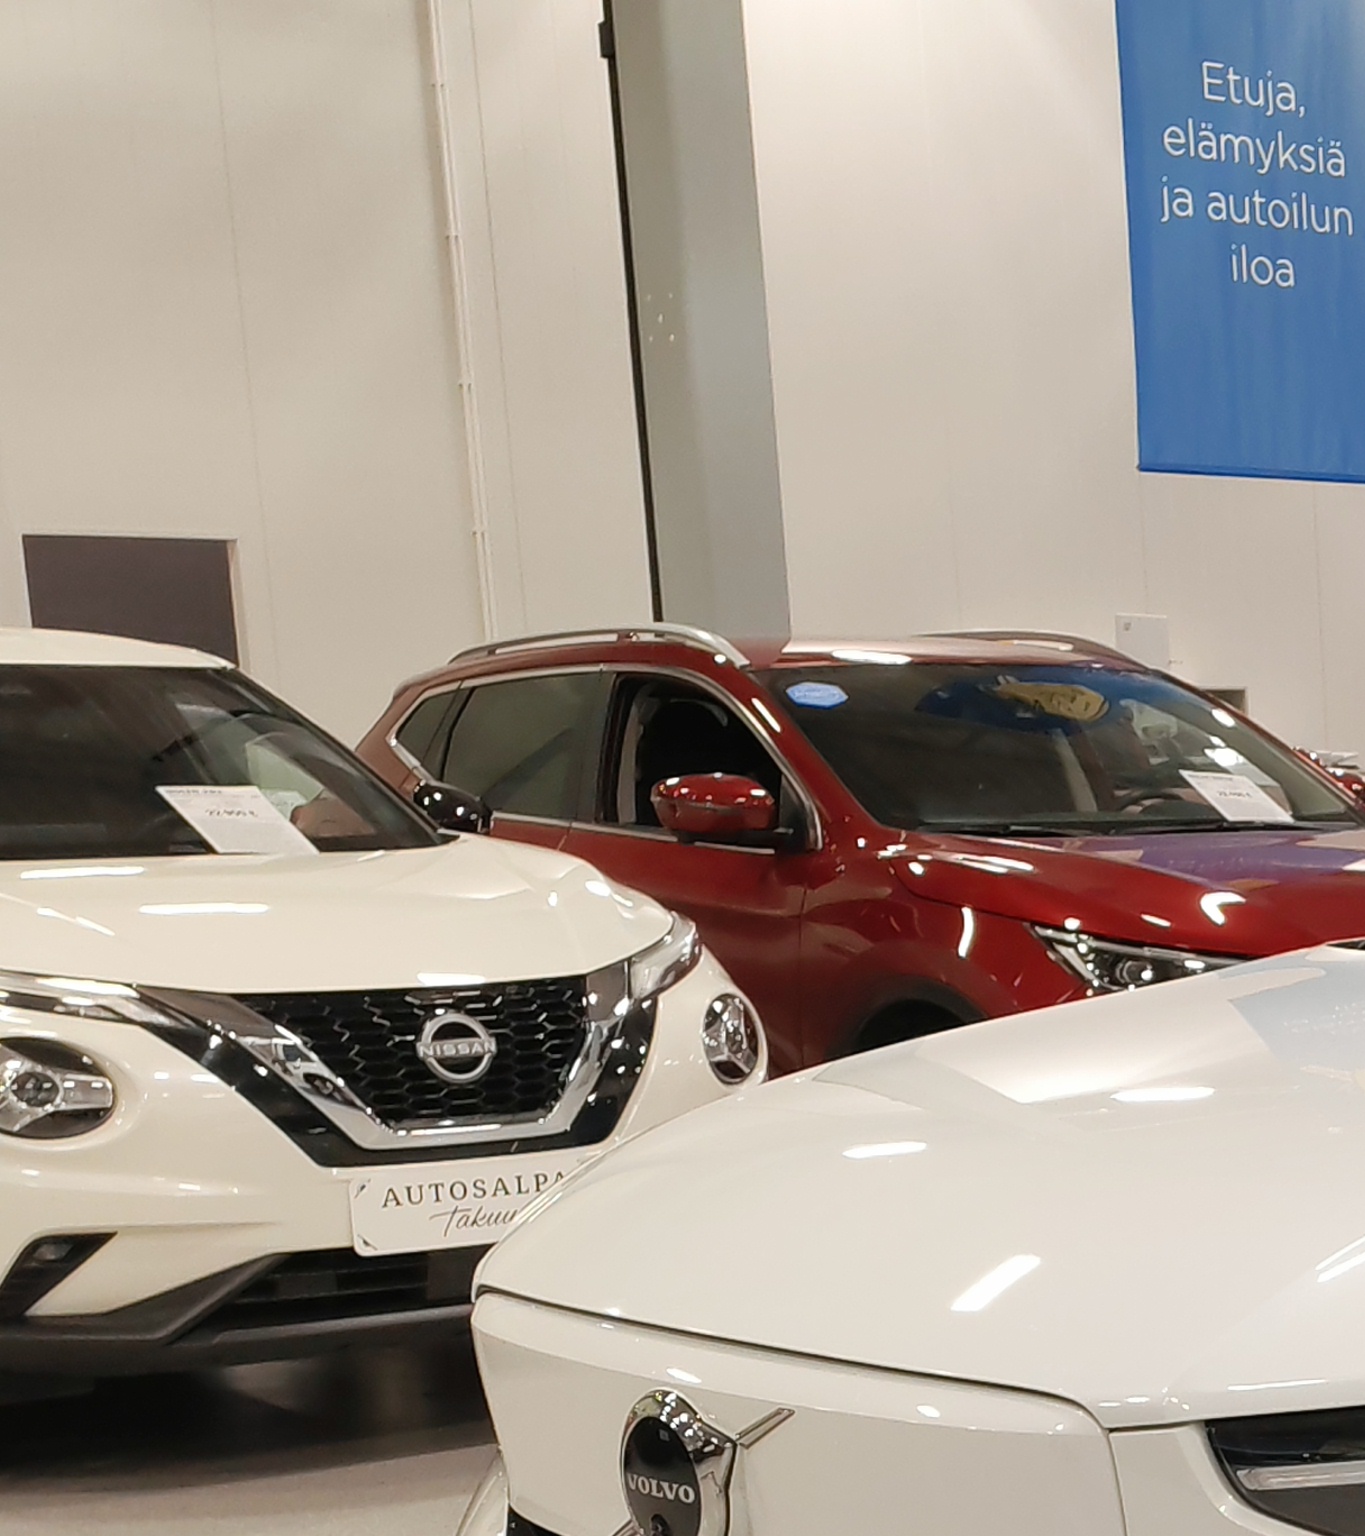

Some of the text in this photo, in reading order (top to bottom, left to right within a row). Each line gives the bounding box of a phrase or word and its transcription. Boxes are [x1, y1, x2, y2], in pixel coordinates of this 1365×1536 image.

[1202, 61, 1306, 118] Etuja,
[1162, 117, 1346, 178] elämyksiä
[1160, 175, 1354, 237] ja autoilun
[1230, 243, 1296, 288] iloa
[625, 1472, 696, 1504] VOLVO
